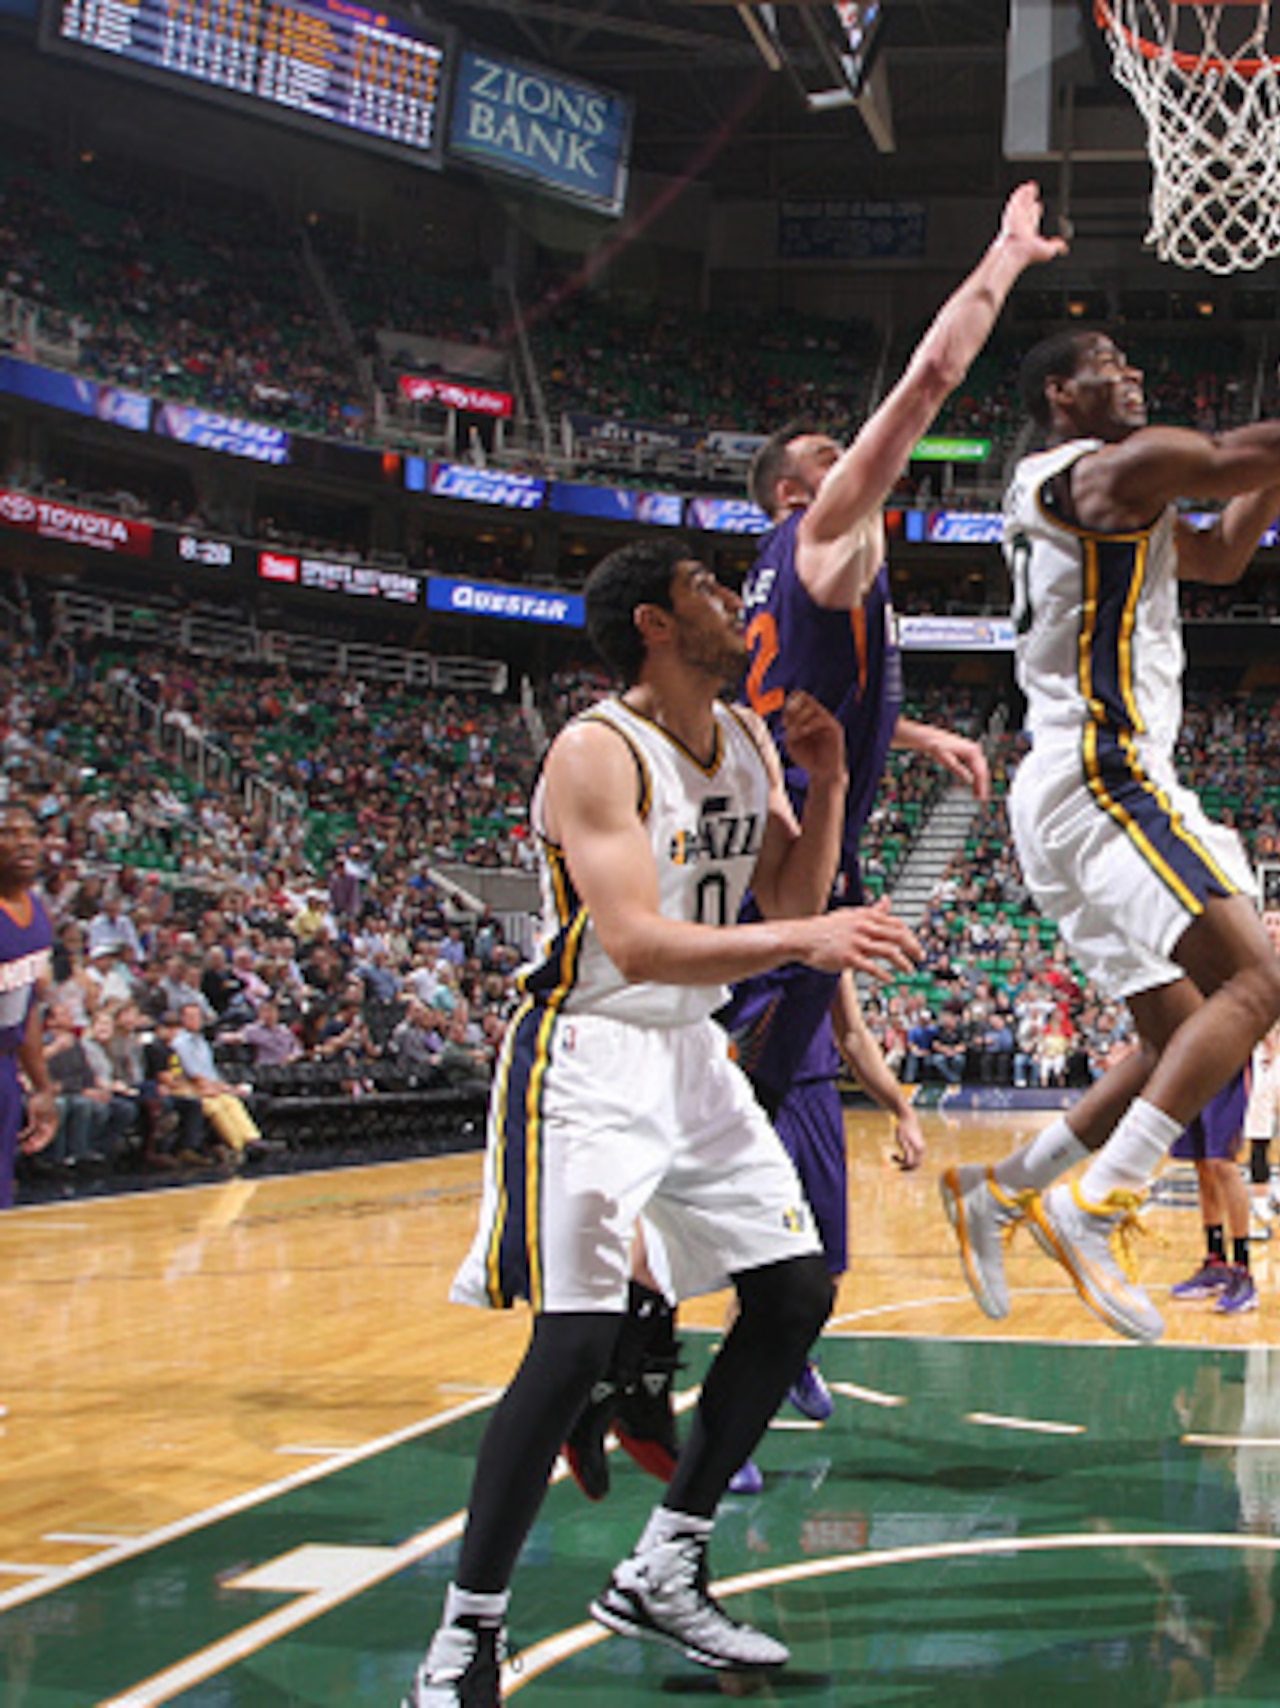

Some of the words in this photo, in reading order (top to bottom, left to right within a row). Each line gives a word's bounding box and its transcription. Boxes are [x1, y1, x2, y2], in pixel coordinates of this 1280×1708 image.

[470, 58, 608, 135] ZIONS
[469, 101, 599, 178] BANK
[37, 503, 129, 543] TOYOTA
